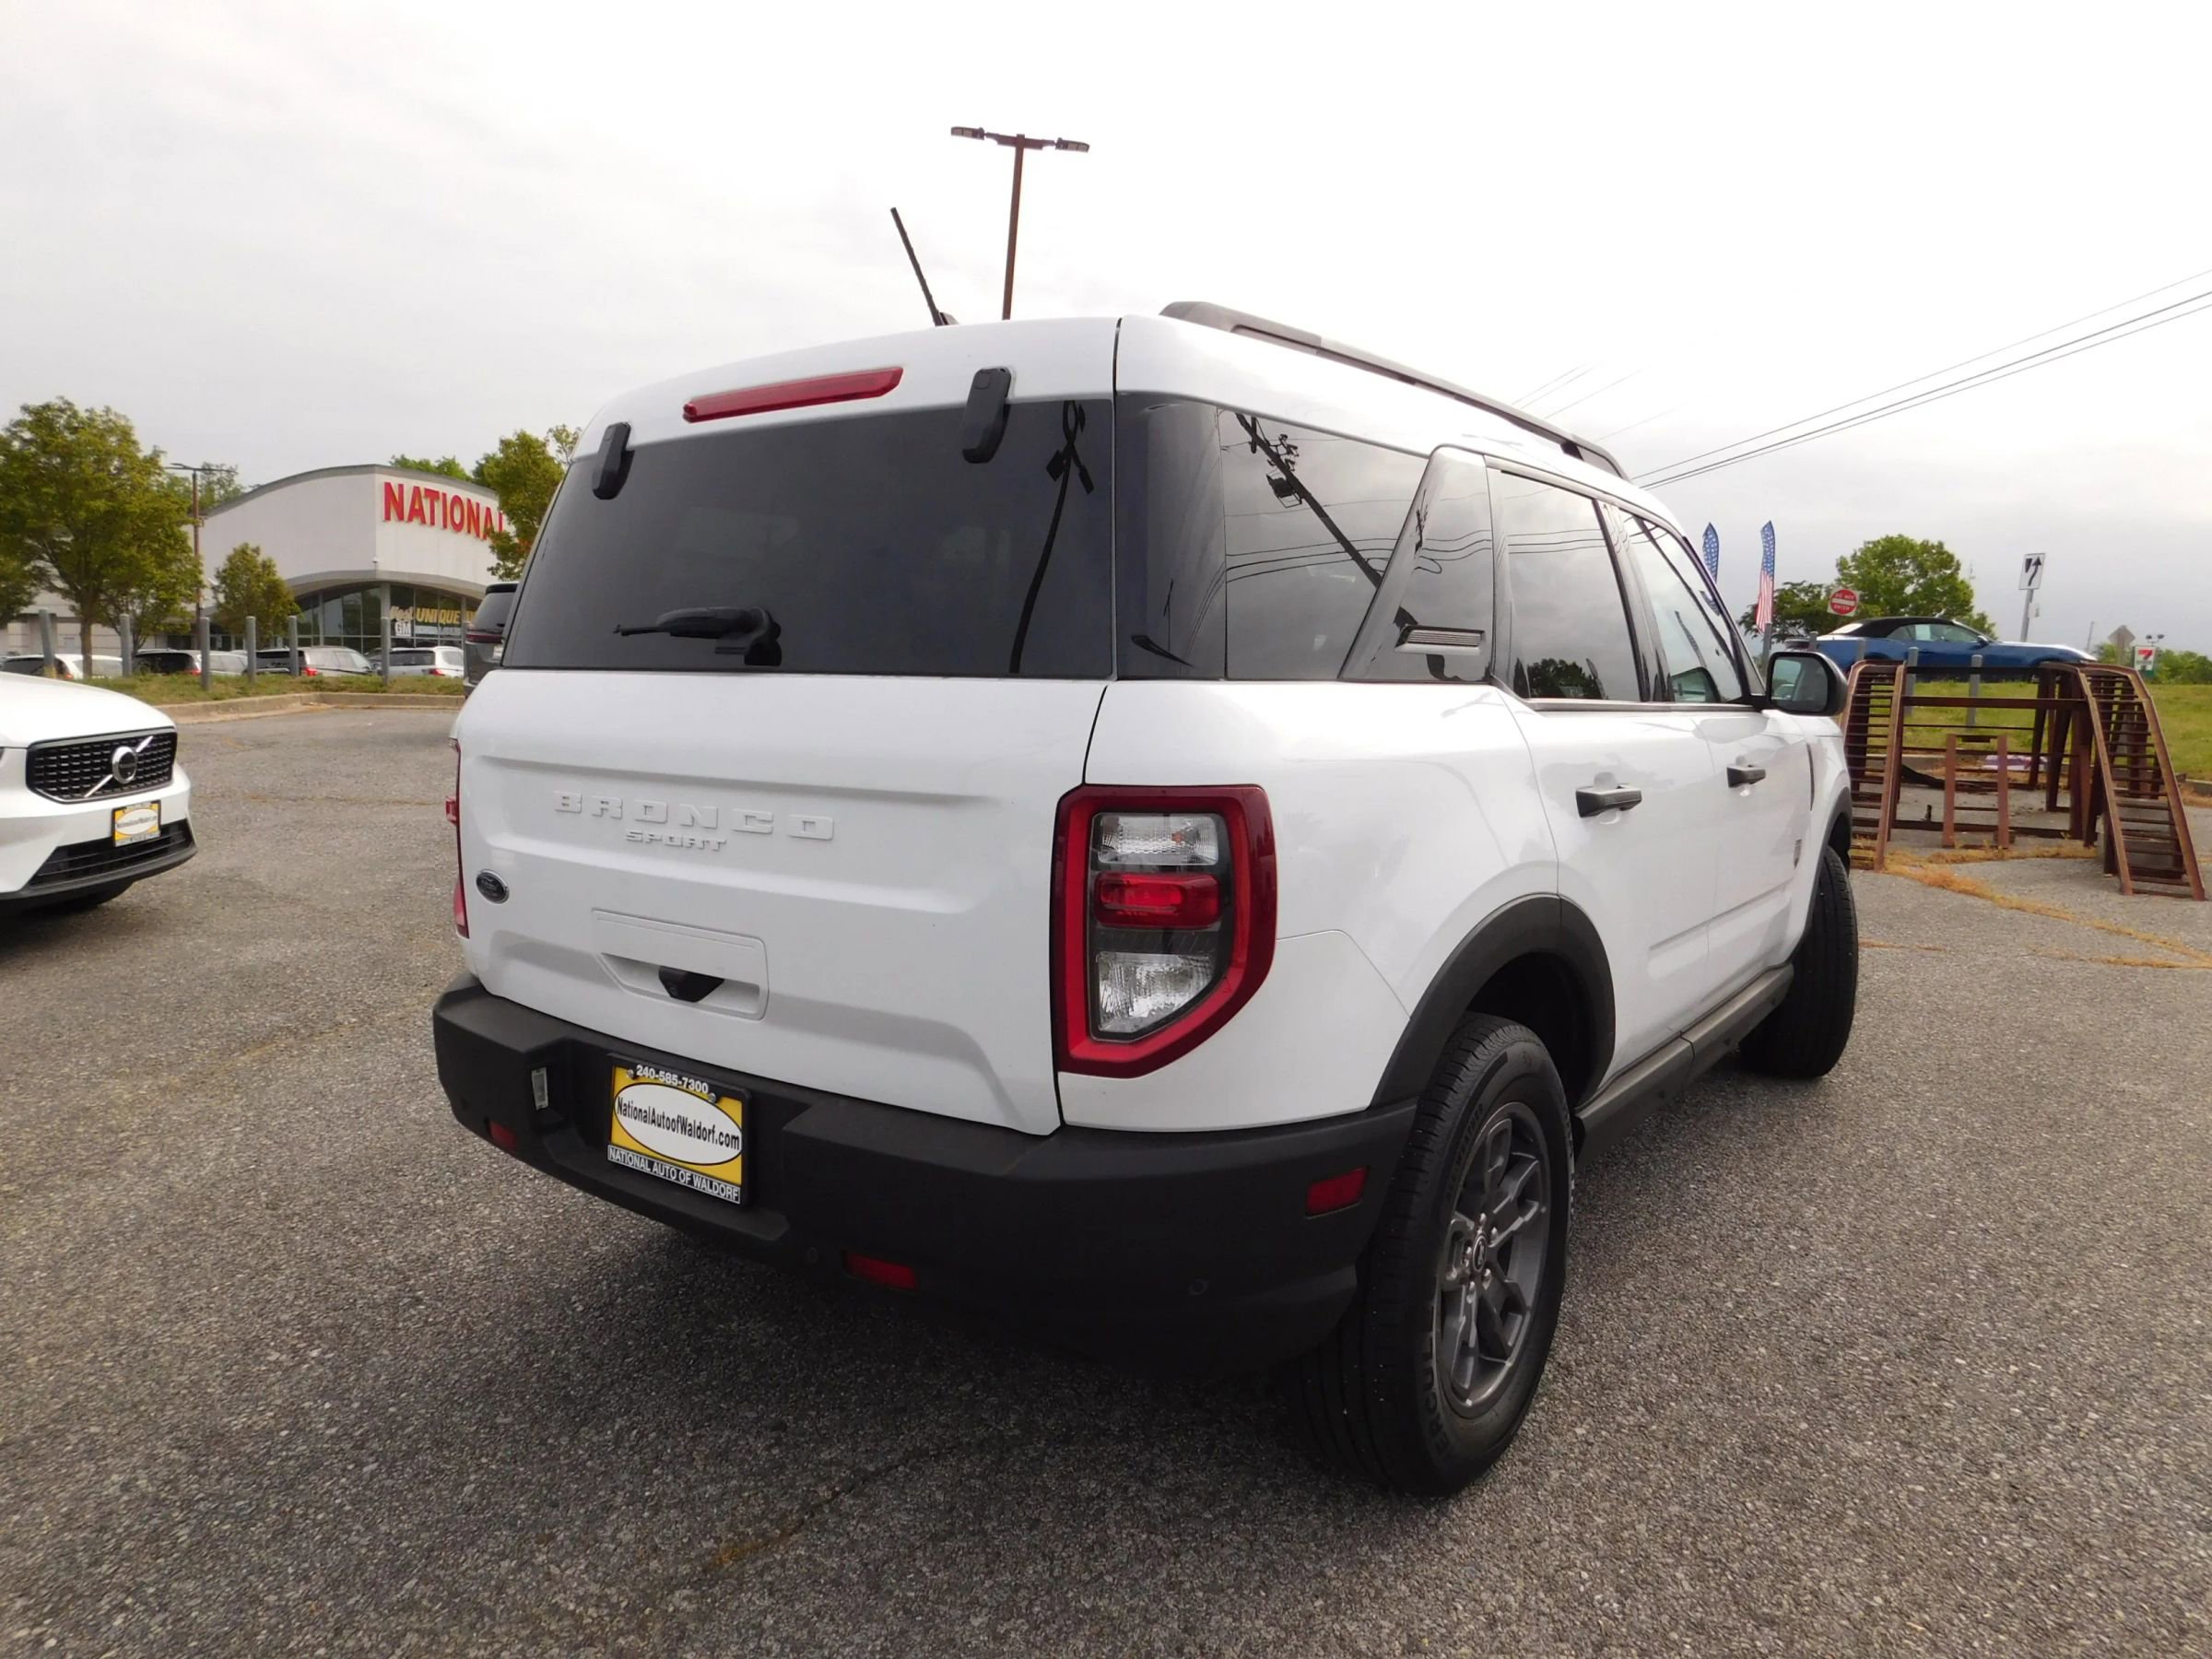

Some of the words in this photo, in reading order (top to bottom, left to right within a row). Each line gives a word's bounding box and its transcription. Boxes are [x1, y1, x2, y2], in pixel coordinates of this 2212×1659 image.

[416, 606, 461, 625] UNIQUE
[553, 790, 834, 841] BRONCO
[625, 829, 727, 852] SPORT
[636, 1065, 710, 1094] 240-585-7300
[617, 1097, 740, 1150] NationalAutoofWaldorf.com
[608, 1147, 652, 1171] NATIONAL
[652, 1160, 677, 1180] AUTO
[678, 1171, 692, 1182] OF
[693, 1174, 739, 1201] WALDORF
